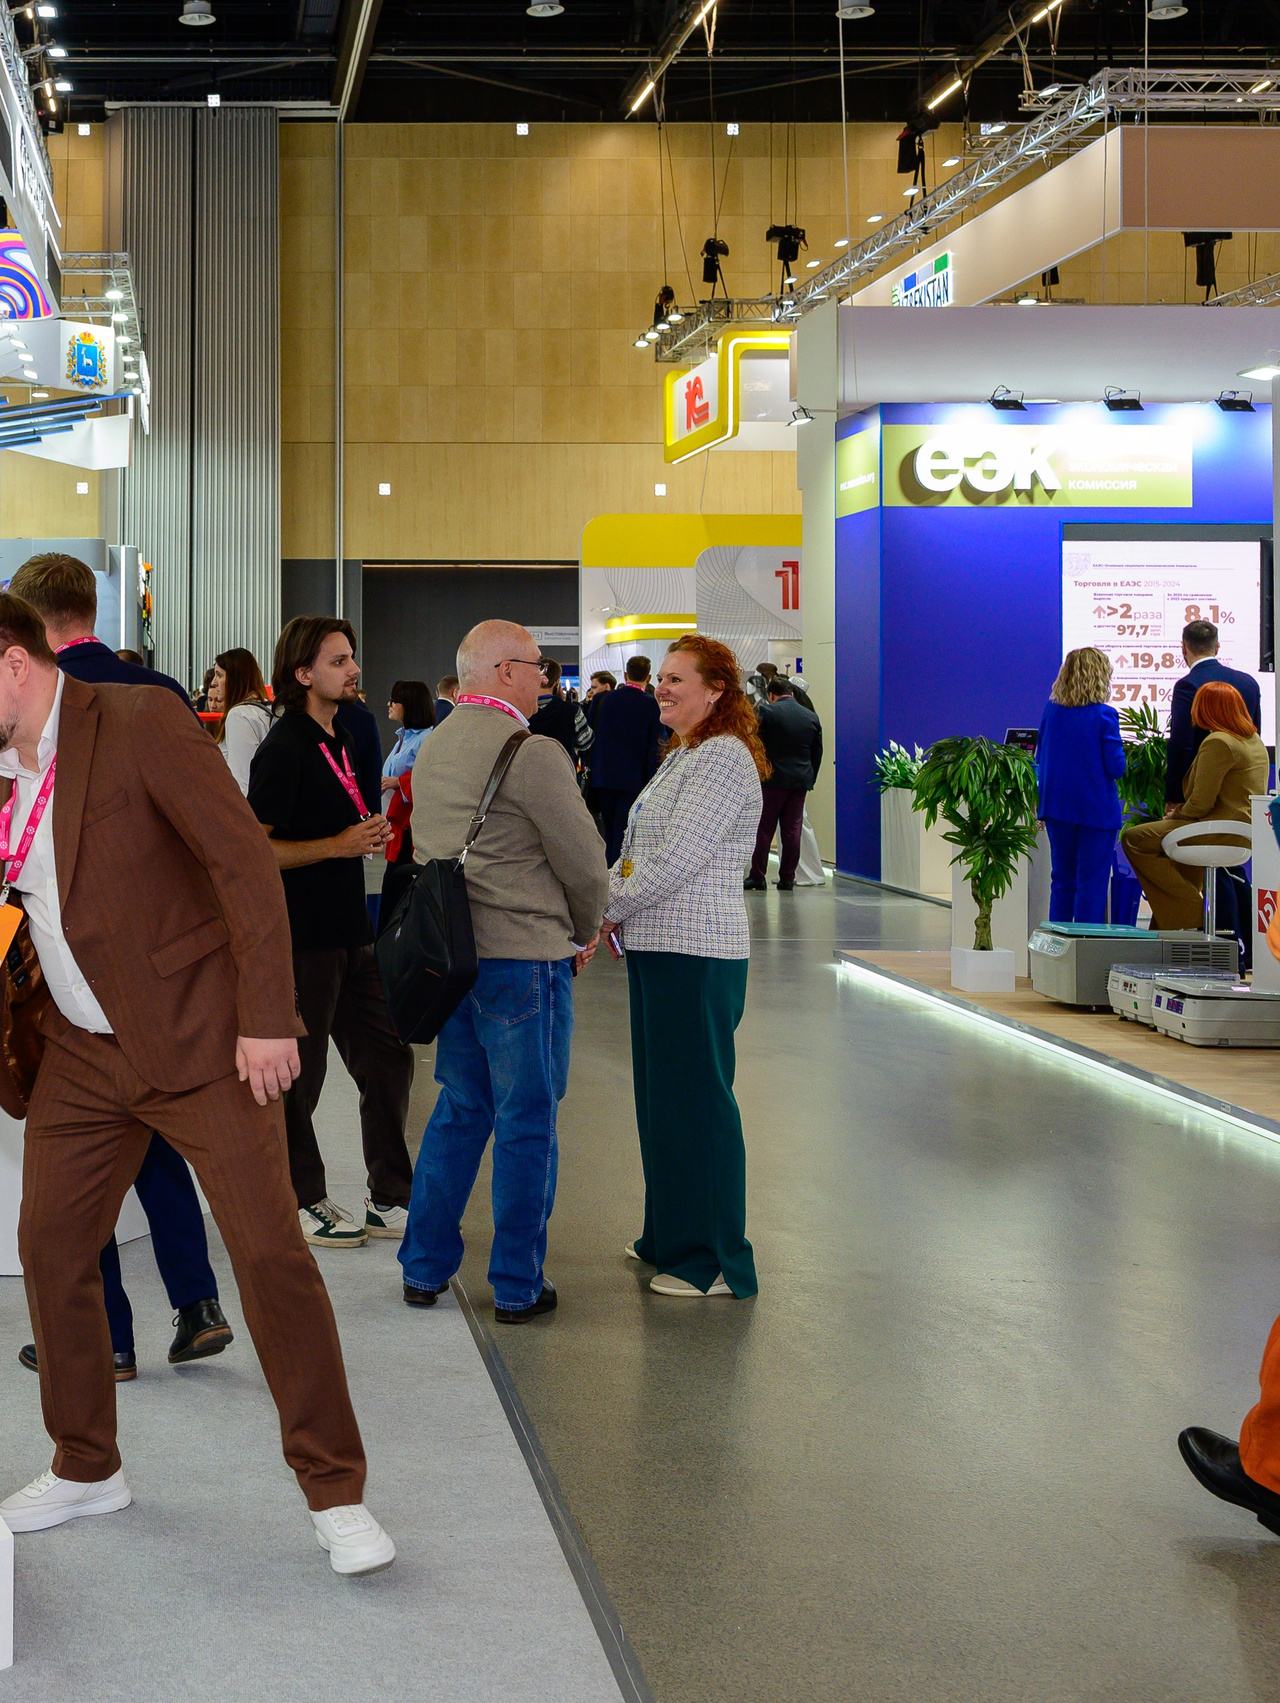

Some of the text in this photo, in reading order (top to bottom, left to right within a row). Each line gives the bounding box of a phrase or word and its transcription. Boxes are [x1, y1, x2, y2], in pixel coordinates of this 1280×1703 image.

[1068, 479, 1138, 490] КОМИССИЯ
[1073, 580, 1111, 589] Торговля
[1144, 580, 1181, 588] 2015-2024
[1133, 611, 1162, 622] раза
[1116, 624, 1150, 638] 97,7
[1130, 652, 1187, 671] 19,8%
